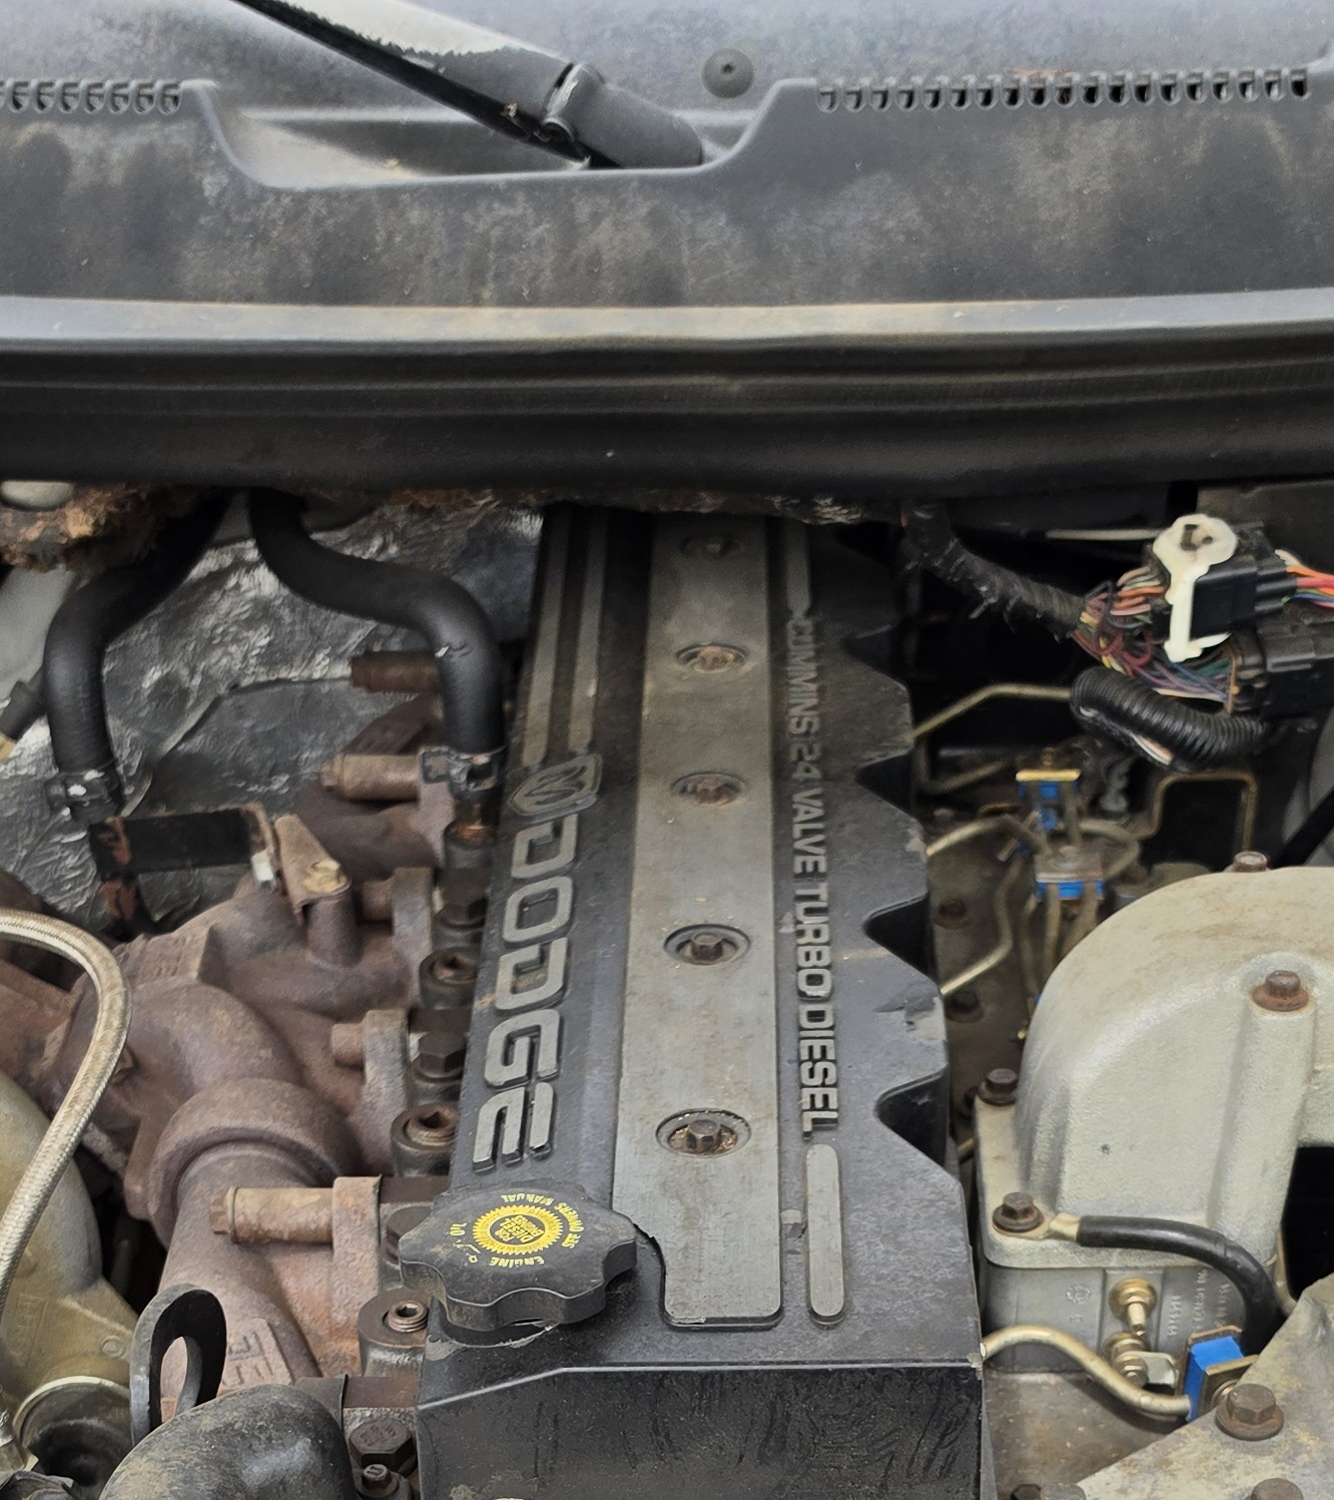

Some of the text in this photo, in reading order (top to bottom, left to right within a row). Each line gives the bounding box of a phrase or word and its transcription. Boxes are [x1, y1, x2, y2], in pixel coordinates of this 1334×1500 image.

[785, 618, 821, 736] CUMMINS
[791, 786, 828, 875] VALVE
[472, 813, 579, 1167] DODGE
[794, 882, 833, 998] TURBO
[798, 1003, 840, 1135] DIESEL
[488, 1255, 546, 1269] ENGINE
